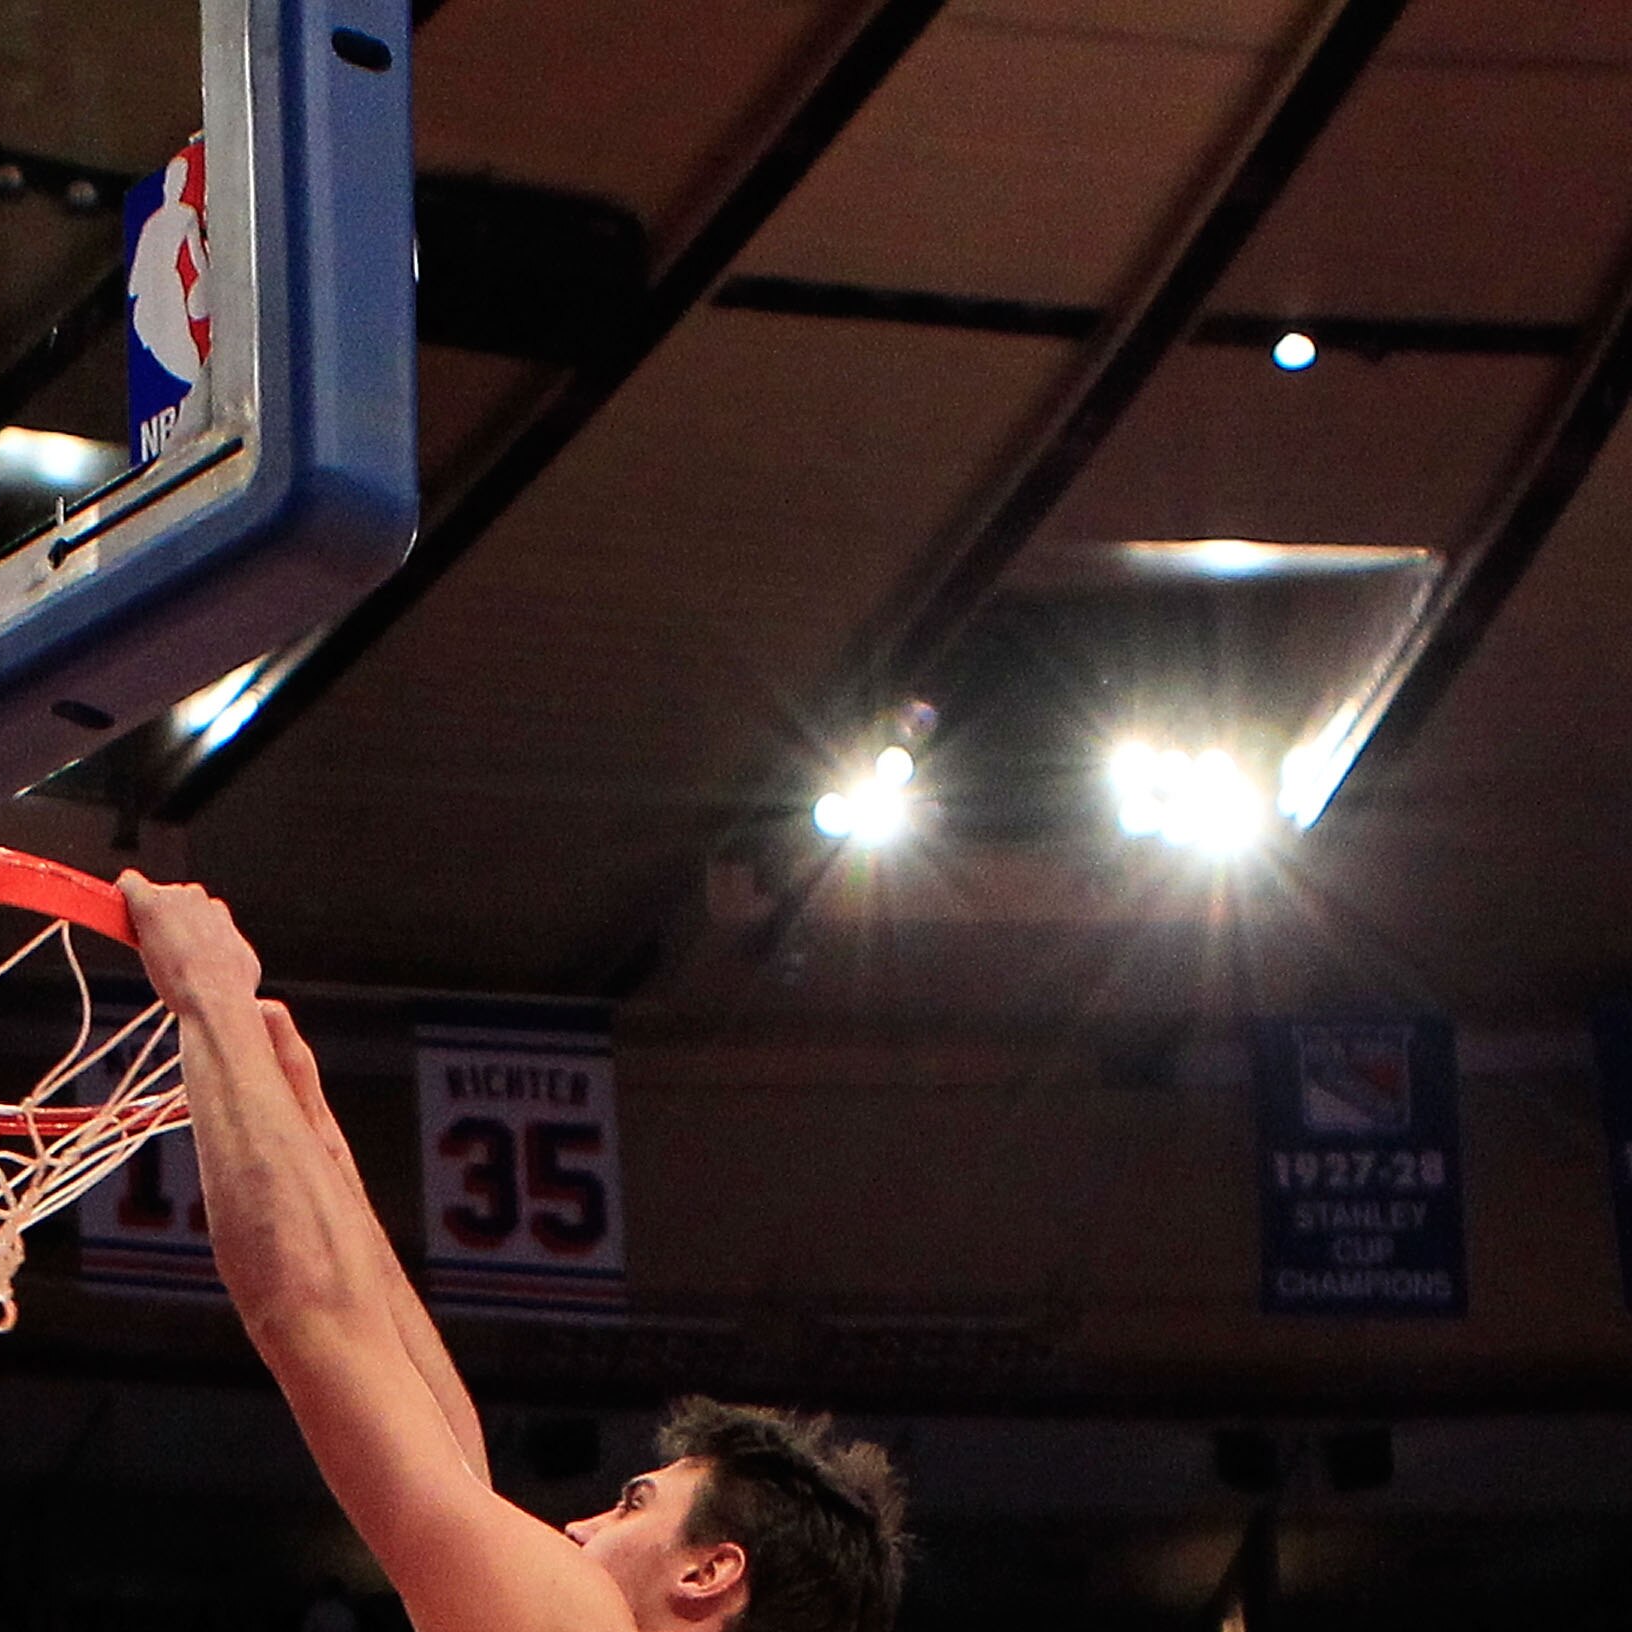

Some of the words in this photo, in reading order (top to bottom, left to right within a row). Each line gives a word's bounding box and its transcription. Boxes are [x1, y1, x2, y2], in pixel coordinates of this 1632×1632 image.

[439, 1117, 608, 1254] 35
[1292, 1200, 1428, 1231] STANLEY
[1331, 1236, 1395, 1264] CUP
[1275, 1268, 1454, 1299] CHAMPIONS
